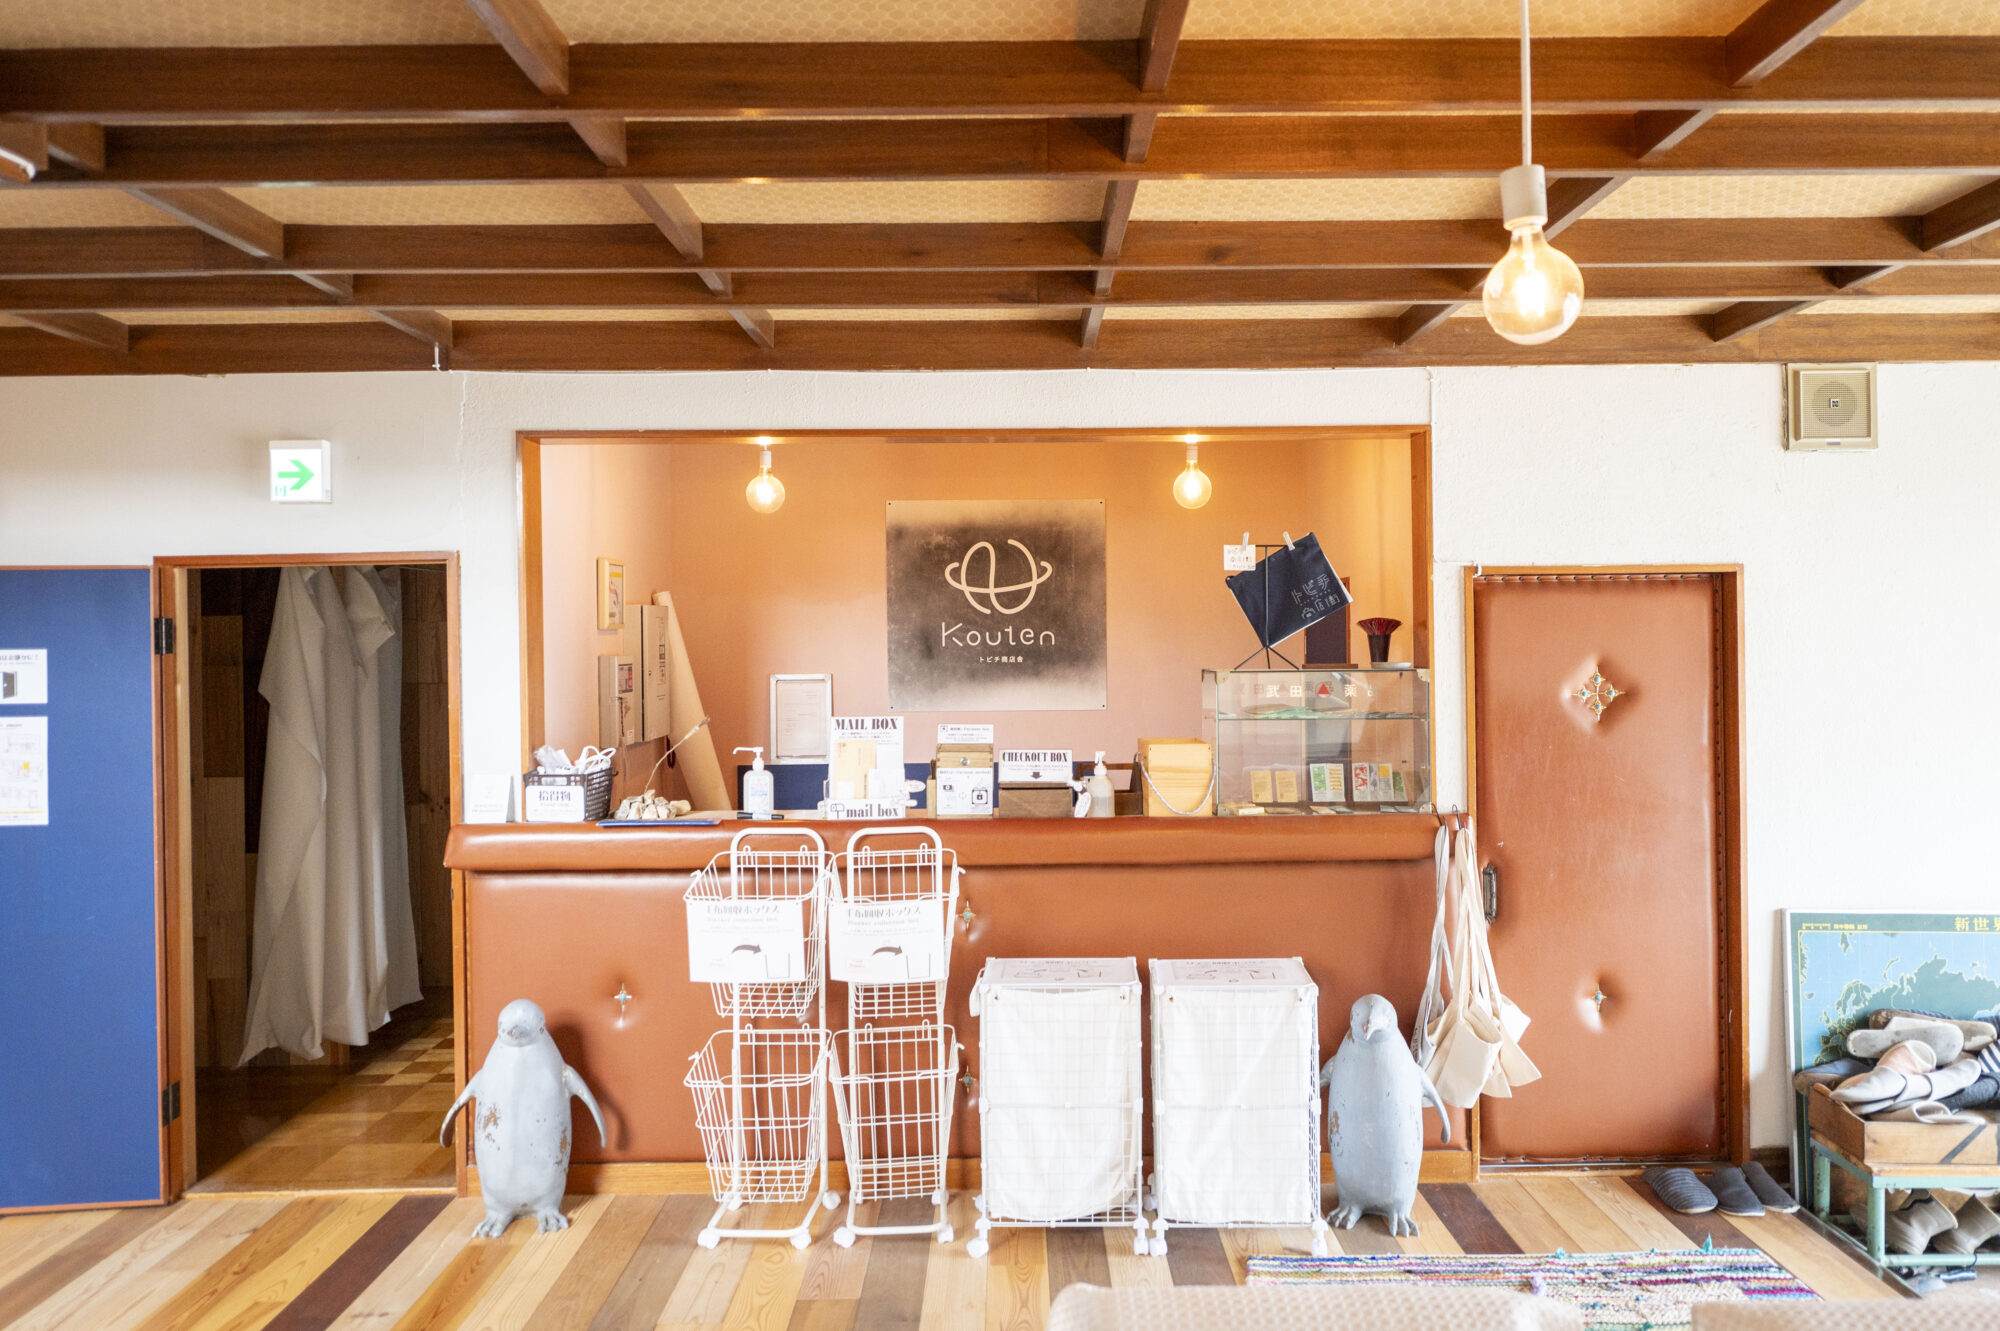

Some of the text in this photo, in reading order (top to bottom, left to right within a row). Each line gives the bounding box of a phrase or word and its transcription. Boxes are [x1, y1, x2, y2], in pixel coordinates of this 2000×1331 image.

[941, 621, 1056, 647] Kouten
[835, 717, 898, 731] MAIL BOX
[1002, 751, 1069, 763] CHECKOUT BOX
[846, 804, 899, 818] mail box
